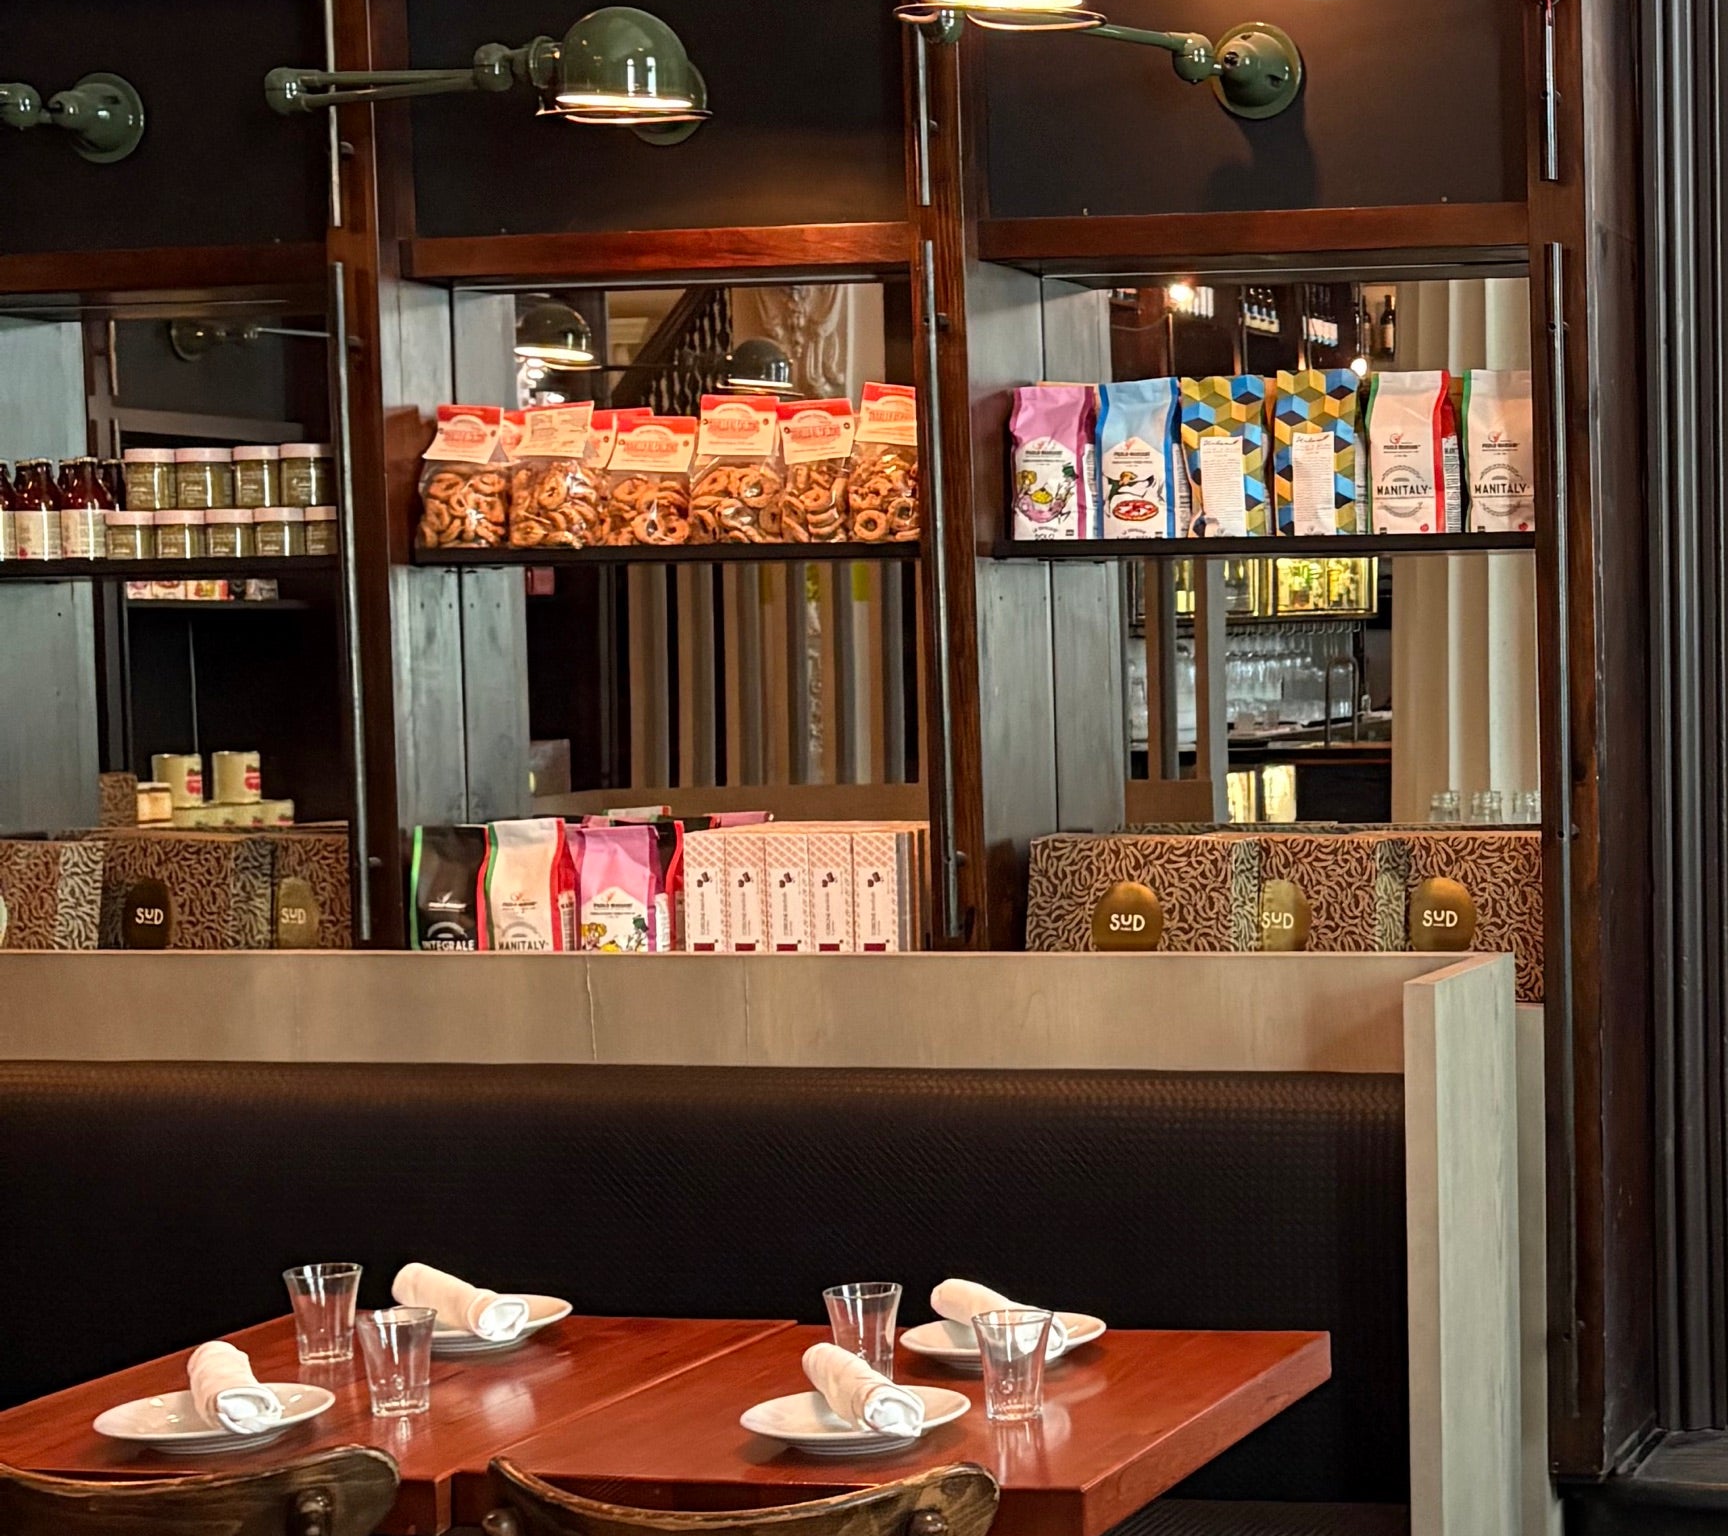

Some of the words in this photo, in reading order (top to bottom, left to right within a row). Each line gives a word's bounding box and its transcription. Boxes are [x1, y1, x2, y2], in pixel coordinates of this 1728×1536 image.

[1376, 484, 1427, 496] MANITALY
[1474, 483, 1525, 494] MANITALY
[135, 907, 164, 925] SUD
[281, 907, 306, 924] SUD
[1109, 913, 1146, 932] SUD
[1261, 910, 1294, 929] SUD
[1422, 909, 1457, 928] SUD
[422, 939, 475, 951] INTEGRALE
